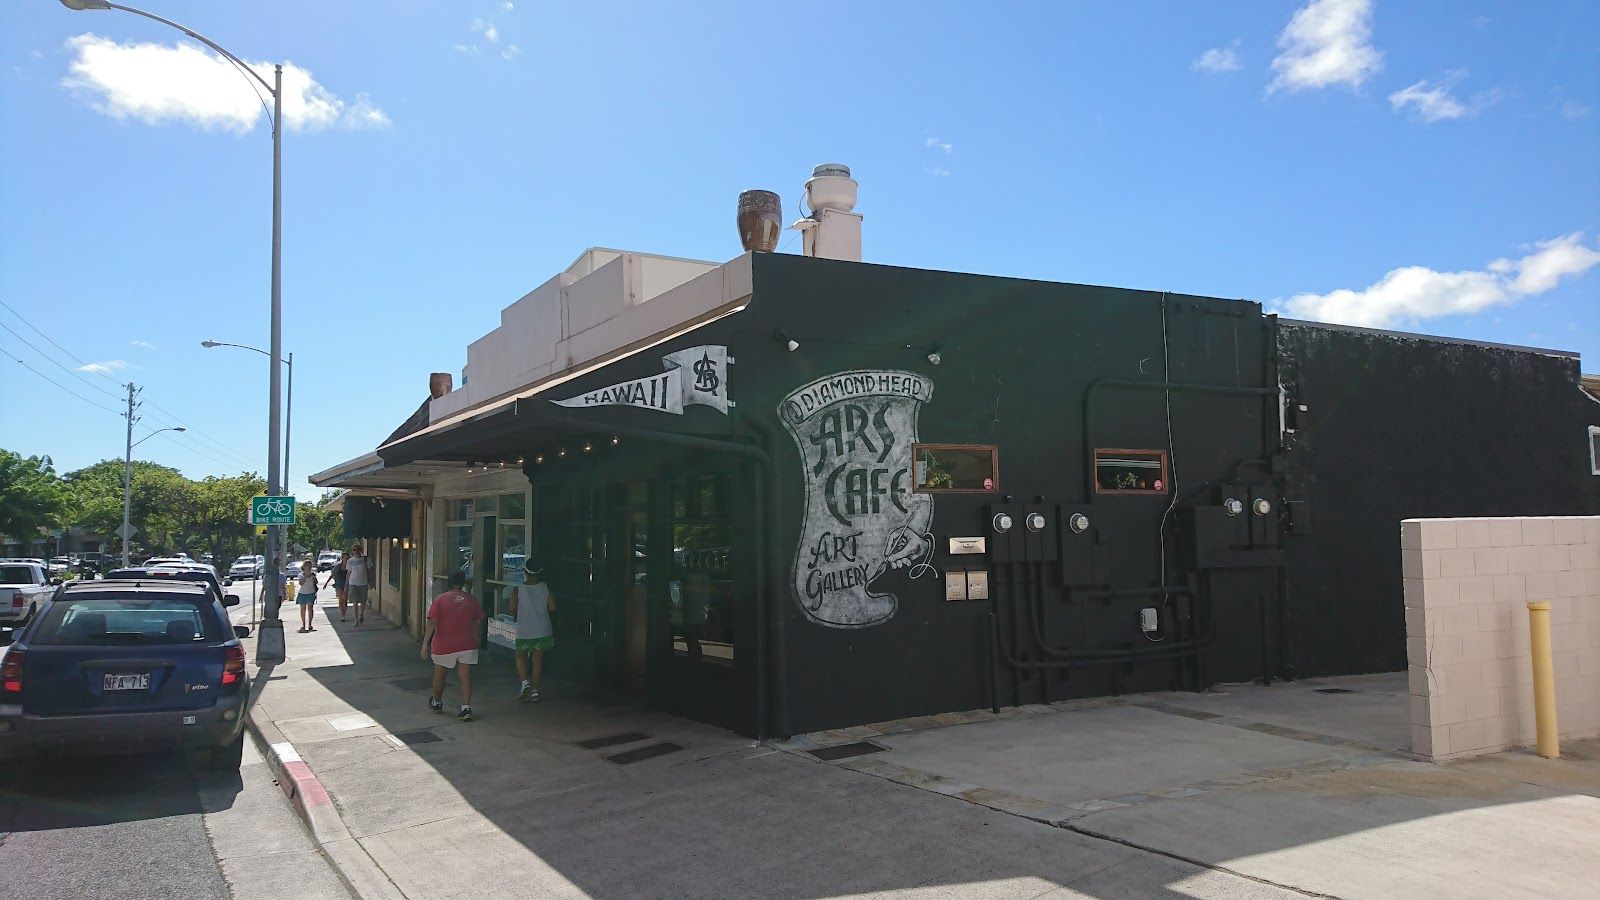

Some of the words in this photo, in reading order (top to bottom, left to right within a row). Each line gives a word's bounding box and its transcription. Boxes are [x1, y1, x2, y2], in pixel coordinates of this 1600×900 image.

[584, 376, 668, 409] HAWAII
[800, 375, 876, 412] DIAMOND
[879, 375, 922, 396] HEAD
[810, 401, 895, 479] ARS
[825, 462, 909, 526] CAFE
[808, 531, 864, 569] ART
[805, 563, 869, 611] GALLERY
[104, 676, 124, 689] NFA
[131, 676, 149, 688] 713
